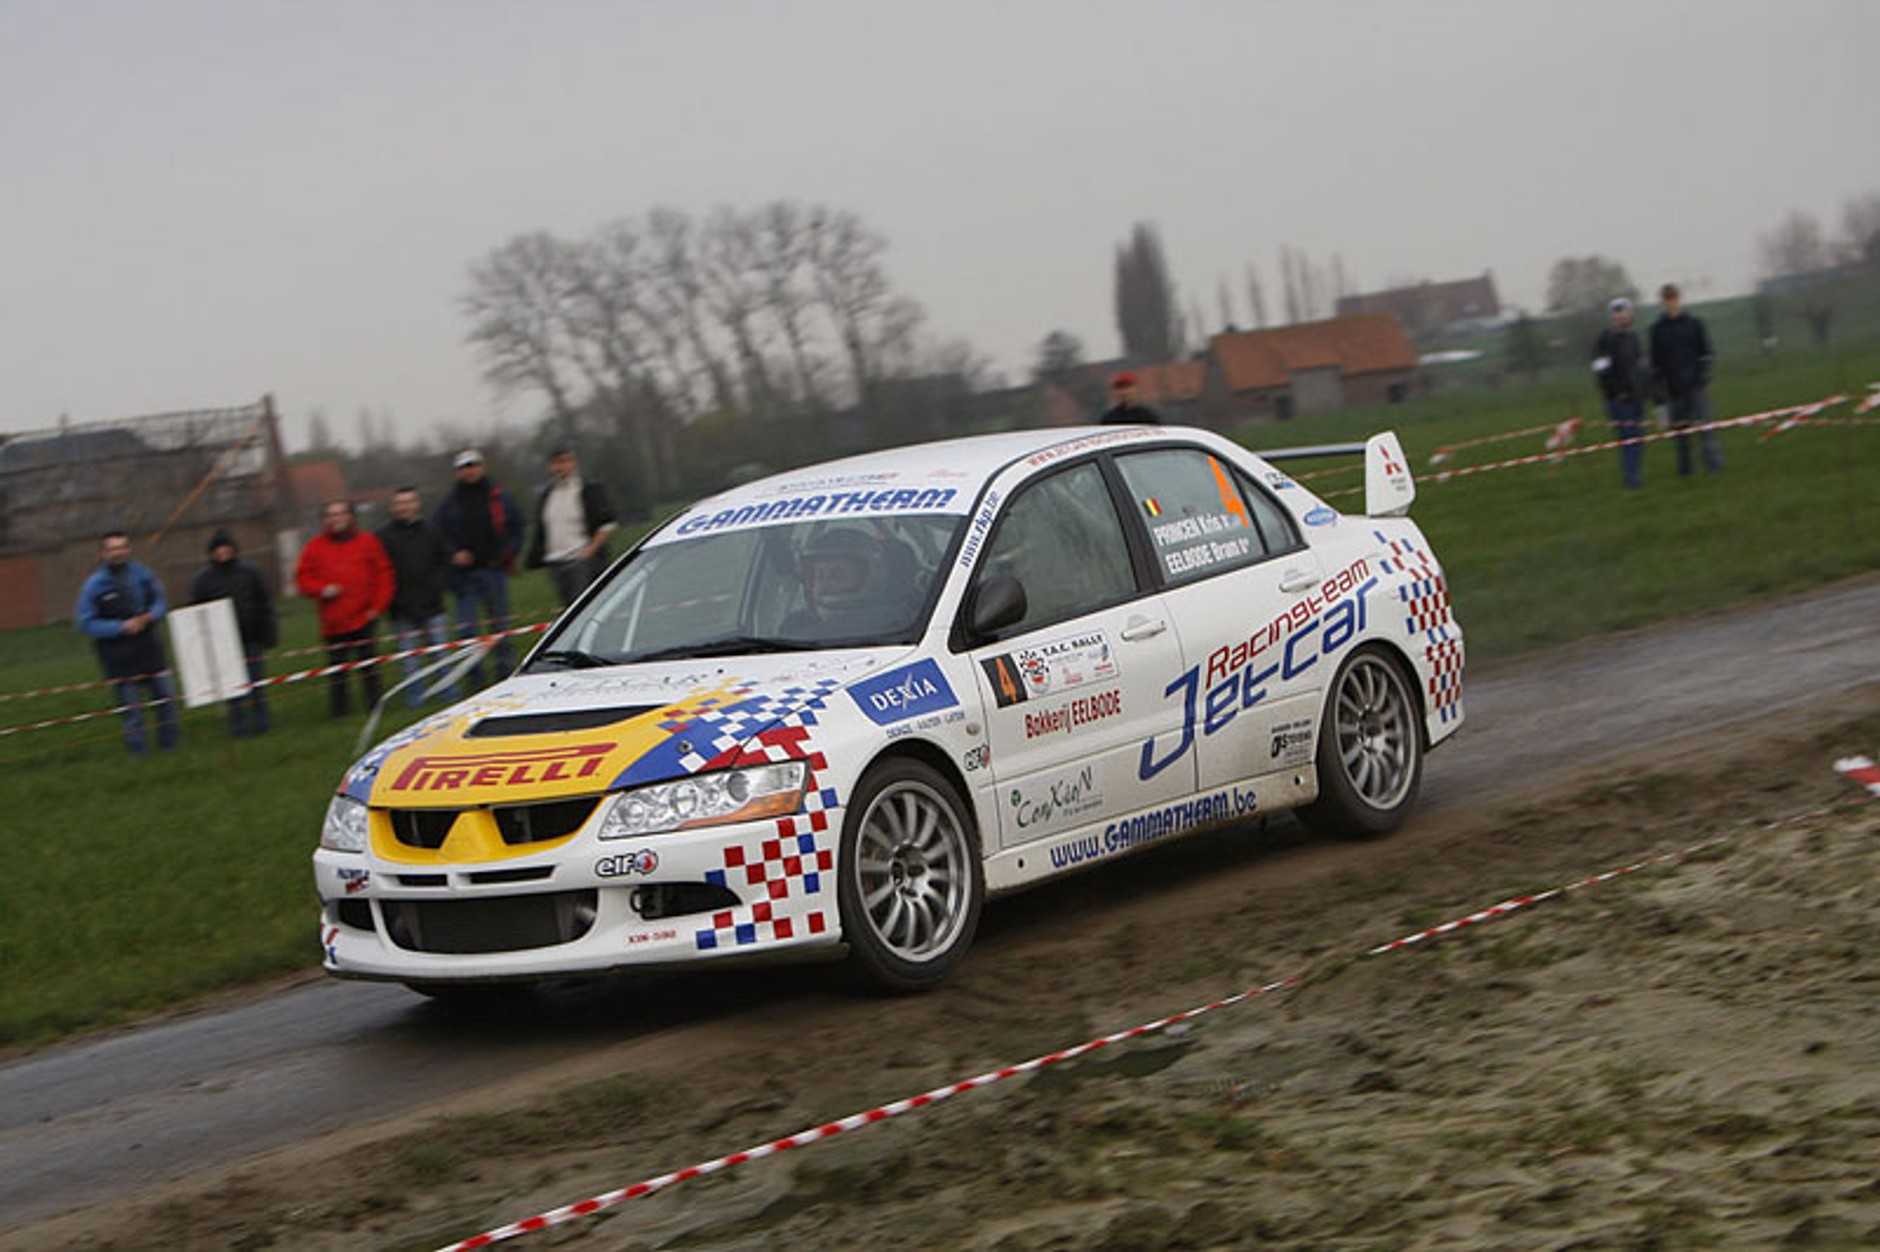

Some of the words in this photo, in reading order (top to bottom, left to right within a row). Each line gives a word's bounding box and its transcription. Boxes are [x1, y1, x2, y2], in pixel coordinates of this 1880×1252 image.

[677, 489, 957, 534] GAMMATHERM
[1208, 455, 1249, 528] 4
[1165, 544, 1214, 574] EELBODE
[1206, 558, 1369, 690] Racingteam
[869, 672, 938, 710] DEXIA
[995, 657, 1017, 705] 4
[1071, 689, 1122, 726] EELBODE
[390, 742, 618, 791] PIRELLI
[1050, 787, 1257, 868] www.GAMMATHERM.be
[595, 853, 638, 877] elf
